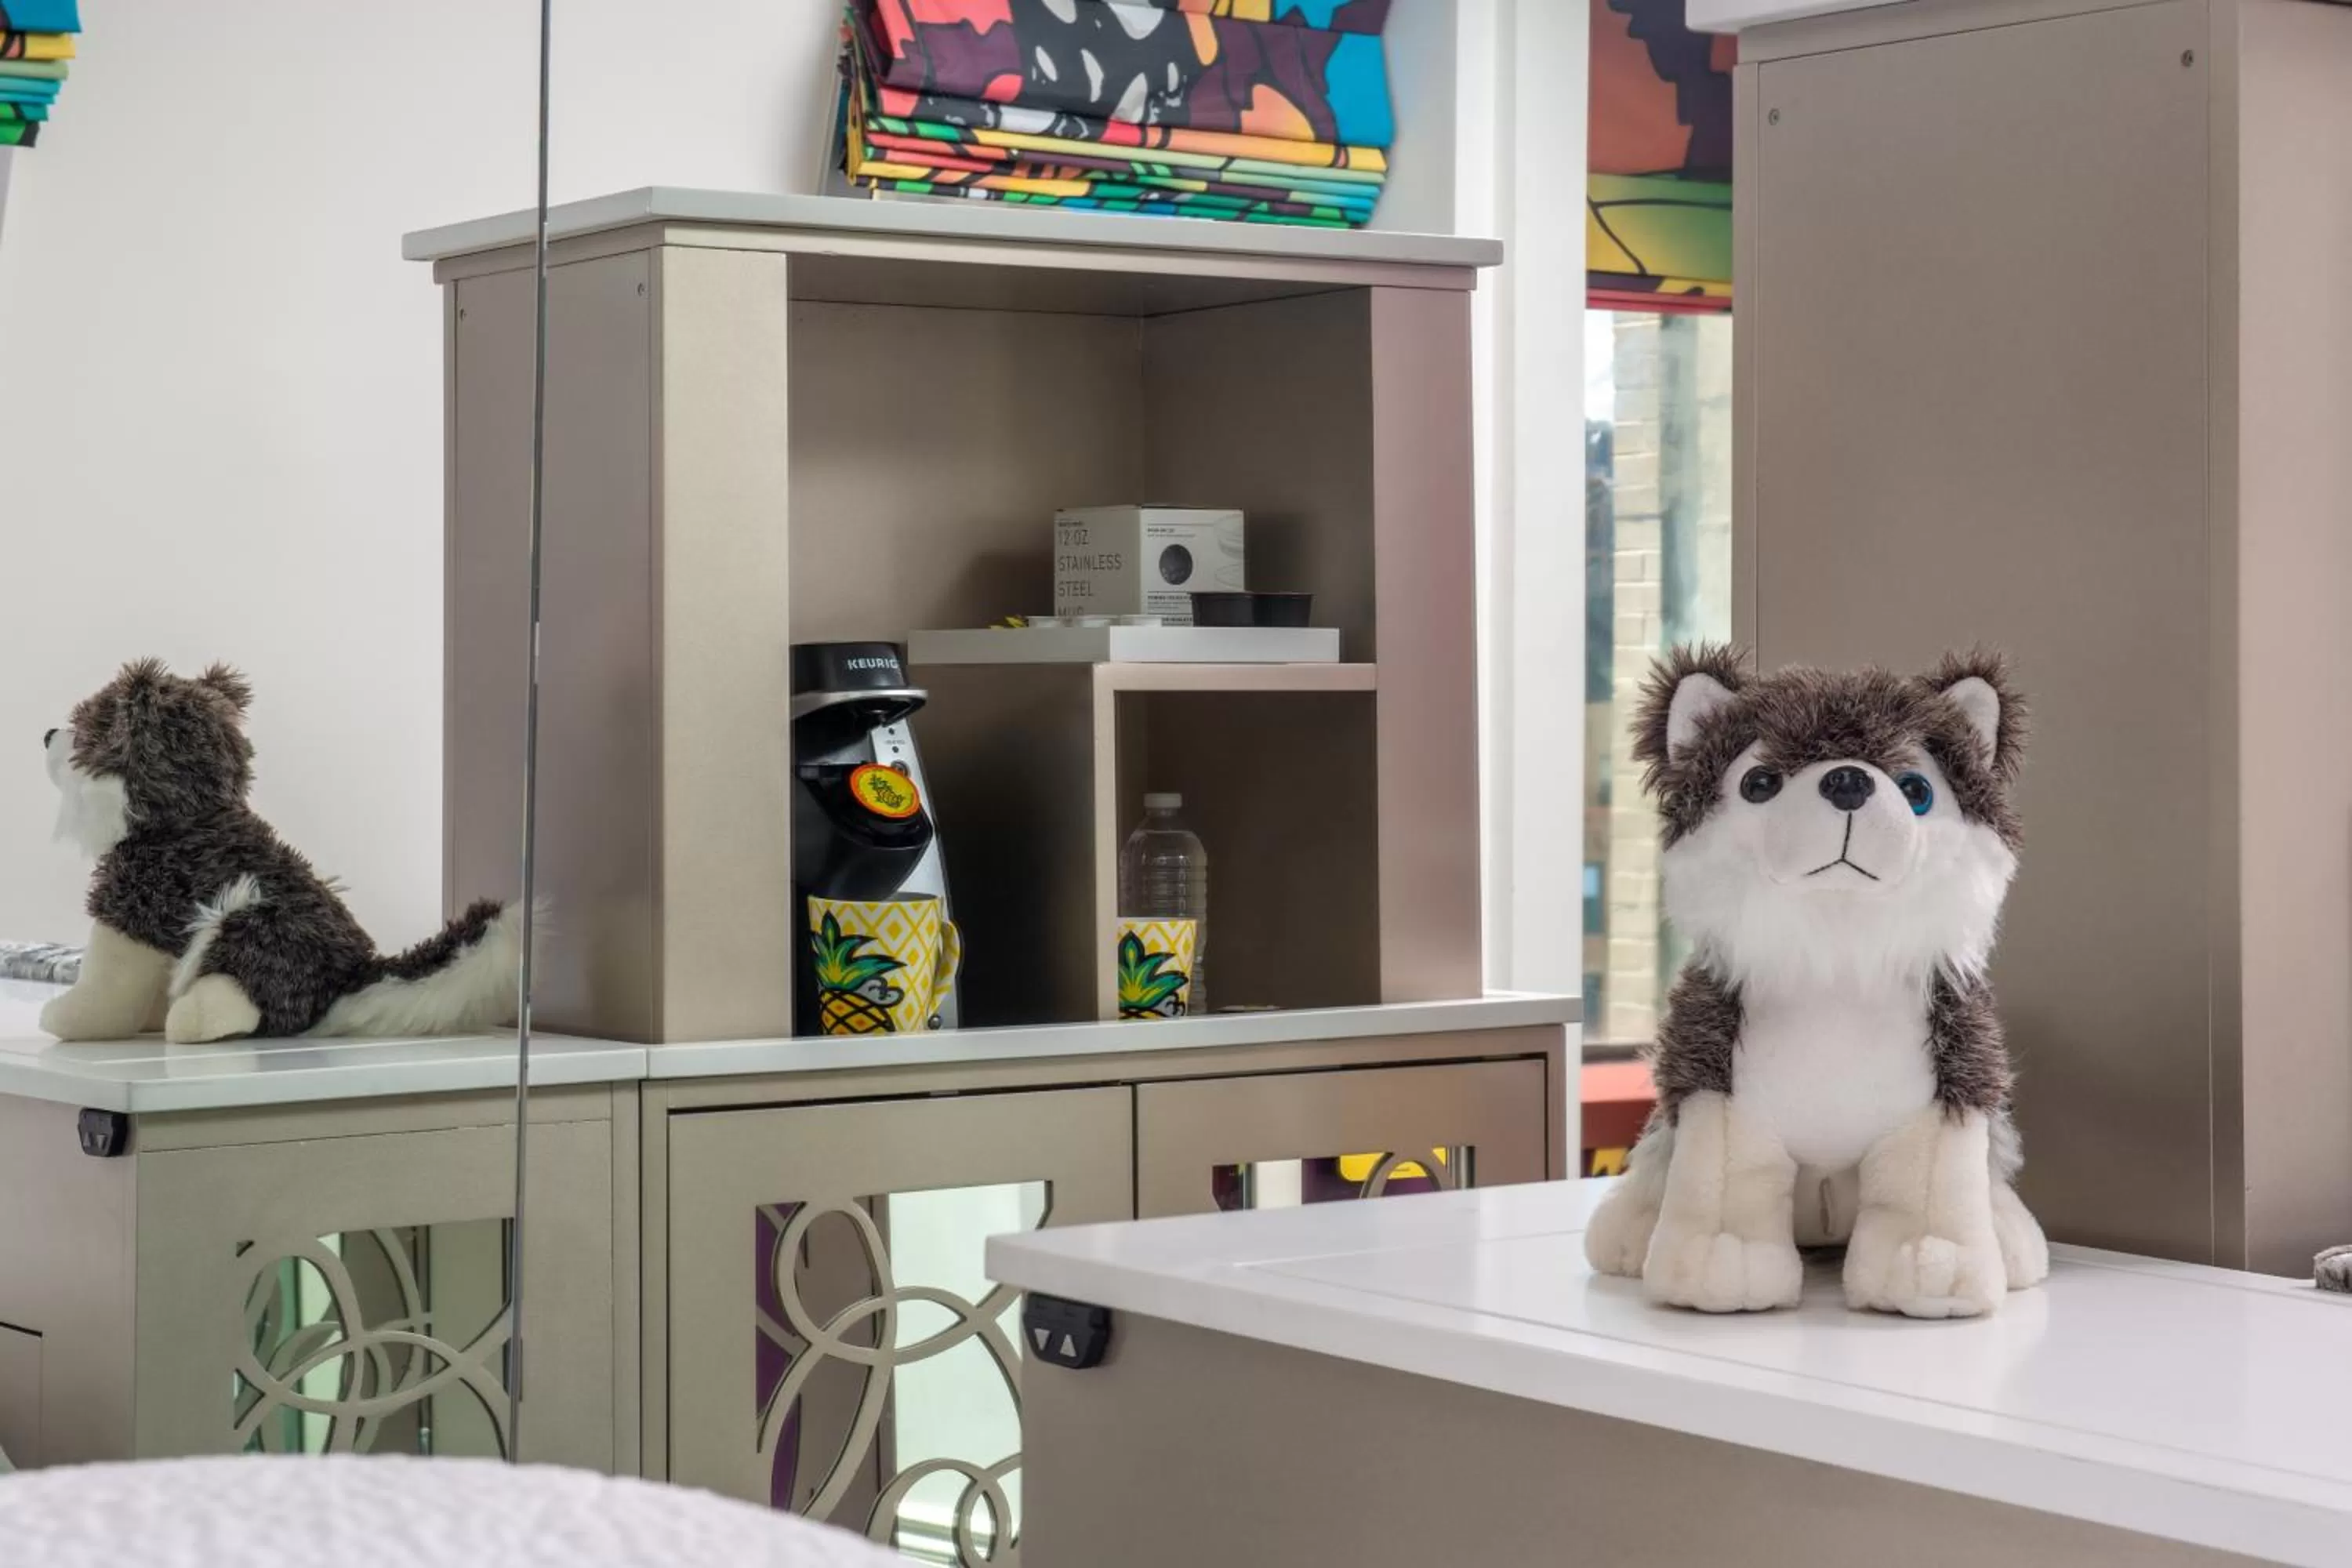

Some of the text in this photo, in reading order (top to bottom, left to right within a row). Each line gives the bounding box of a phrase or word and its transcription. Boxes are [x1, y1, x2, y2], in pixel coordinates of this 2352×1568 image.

[1058, 529, 1070, 546] 12
[1057, 553, 1122, 572] STAINLESS
[1057, 580, 1094, 597] STEEL
[848, 658, 899, 670] KEURIG
